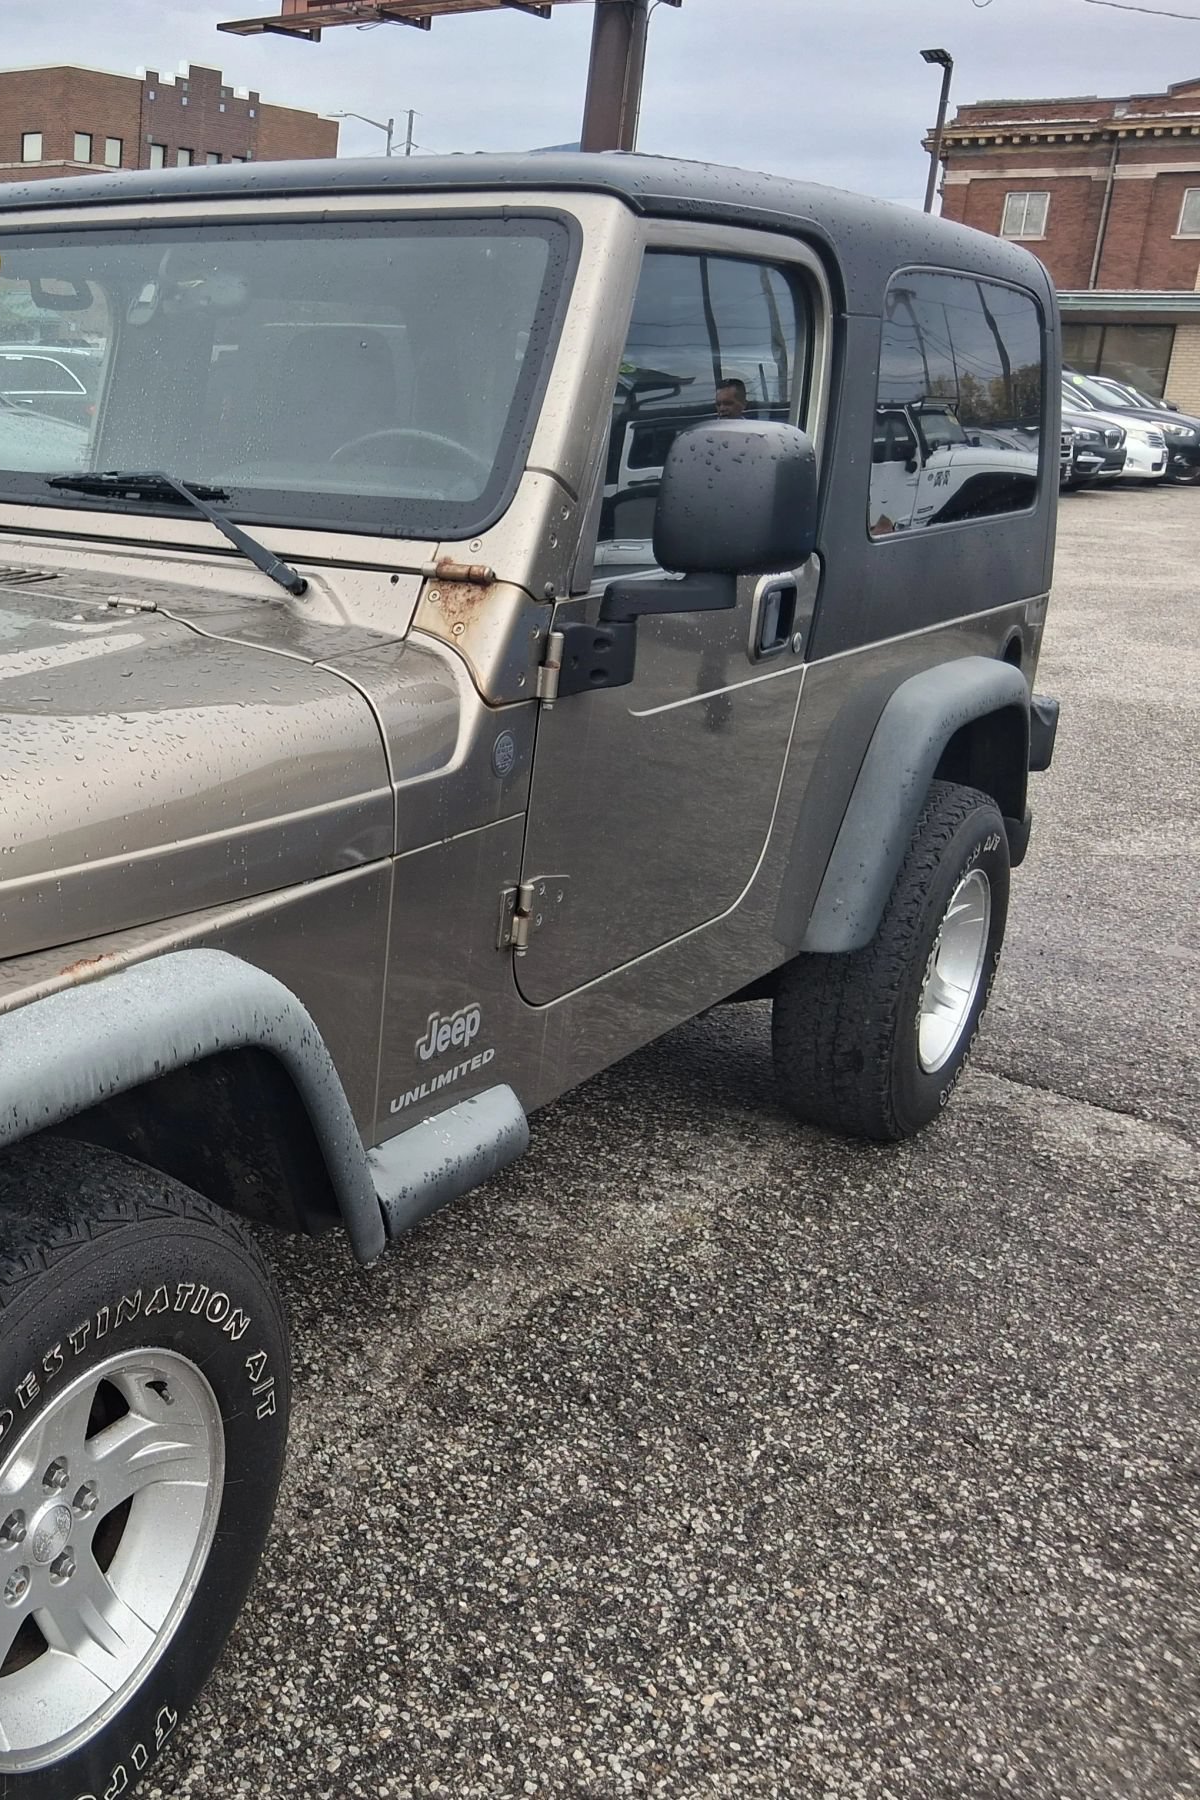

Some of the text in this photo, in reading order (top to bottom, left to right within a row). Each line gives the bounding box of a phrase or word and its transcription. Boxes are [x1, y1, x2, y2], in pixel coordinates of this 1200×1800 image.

[416, 1003, 481, 1061] Jeep
[390, 1048, 495, 1114] UNLIMITED
[245, 1350, 277, 1420] A/T
